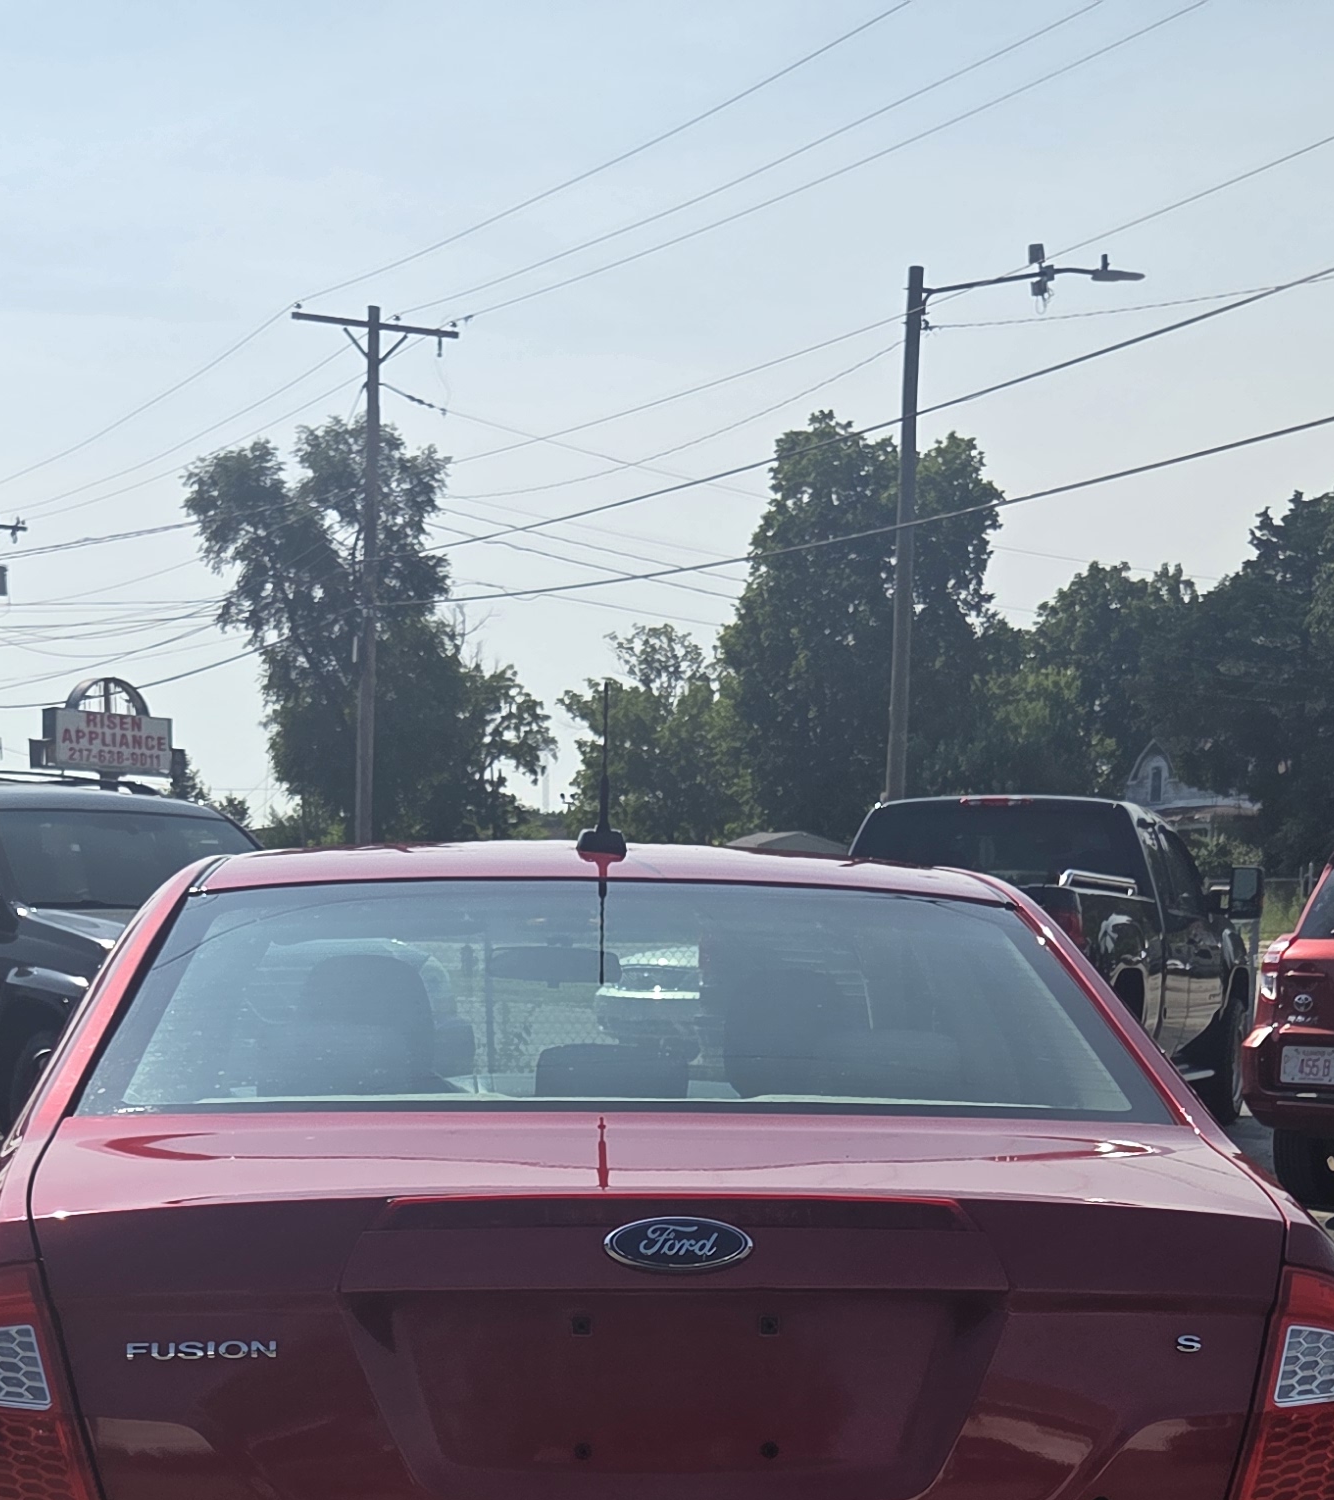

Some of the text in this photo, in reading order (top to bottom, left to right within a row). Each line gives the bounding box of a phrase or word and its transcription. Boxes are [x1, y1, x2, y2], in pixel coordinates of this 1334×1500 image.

[86, 713, 142, 732] RISEN
[62, 728, 166, 752] APPLIANCE
[639, 1224, 719, 1256] Ford
[126, 1340, 277, 1361] FUSION
[1176, 1334, 1202, 1353] S
